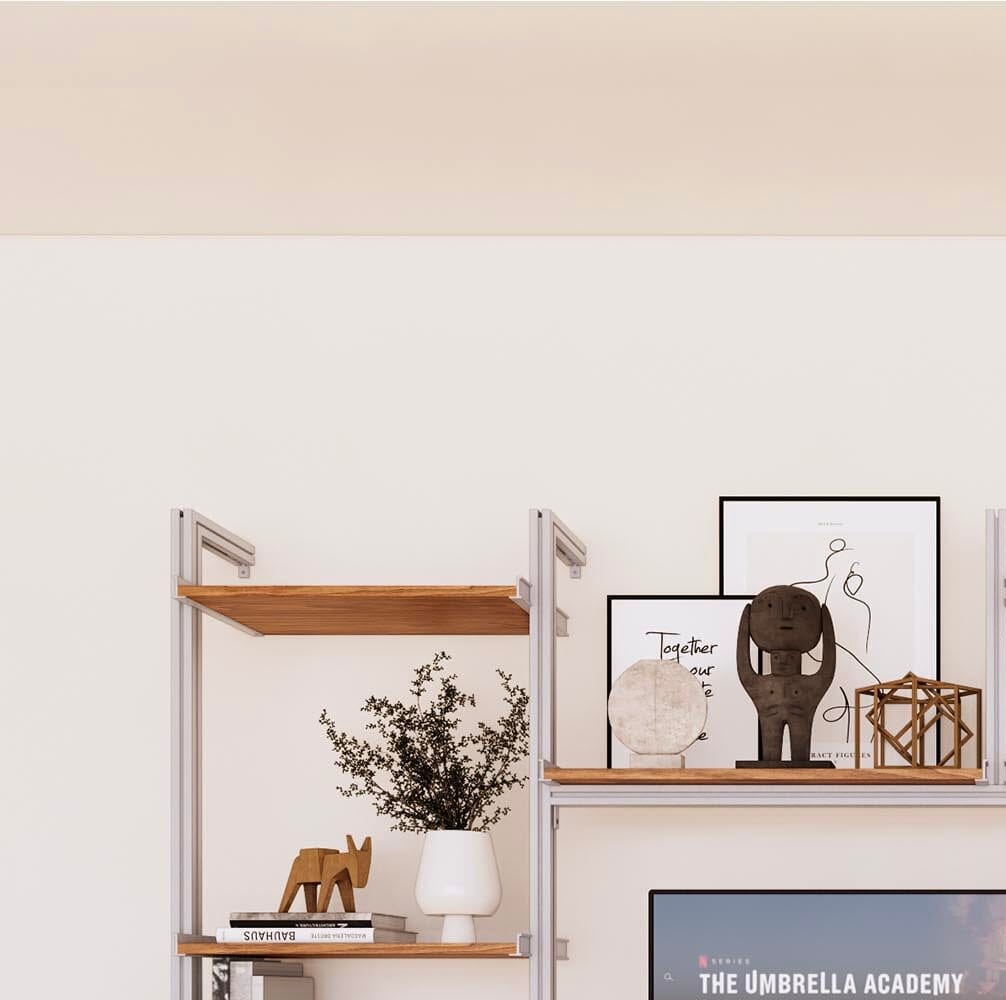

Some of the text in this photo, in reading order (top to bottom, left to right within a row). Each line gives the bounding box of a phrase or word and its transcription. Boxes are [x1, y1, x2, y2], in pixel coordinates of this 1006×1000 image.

[646, 631, 719, 664] Together
[244, 931, 296, 940] BAUHAUS
[699, 970, 964, 996] THE UMBRELLA ACADEMY
